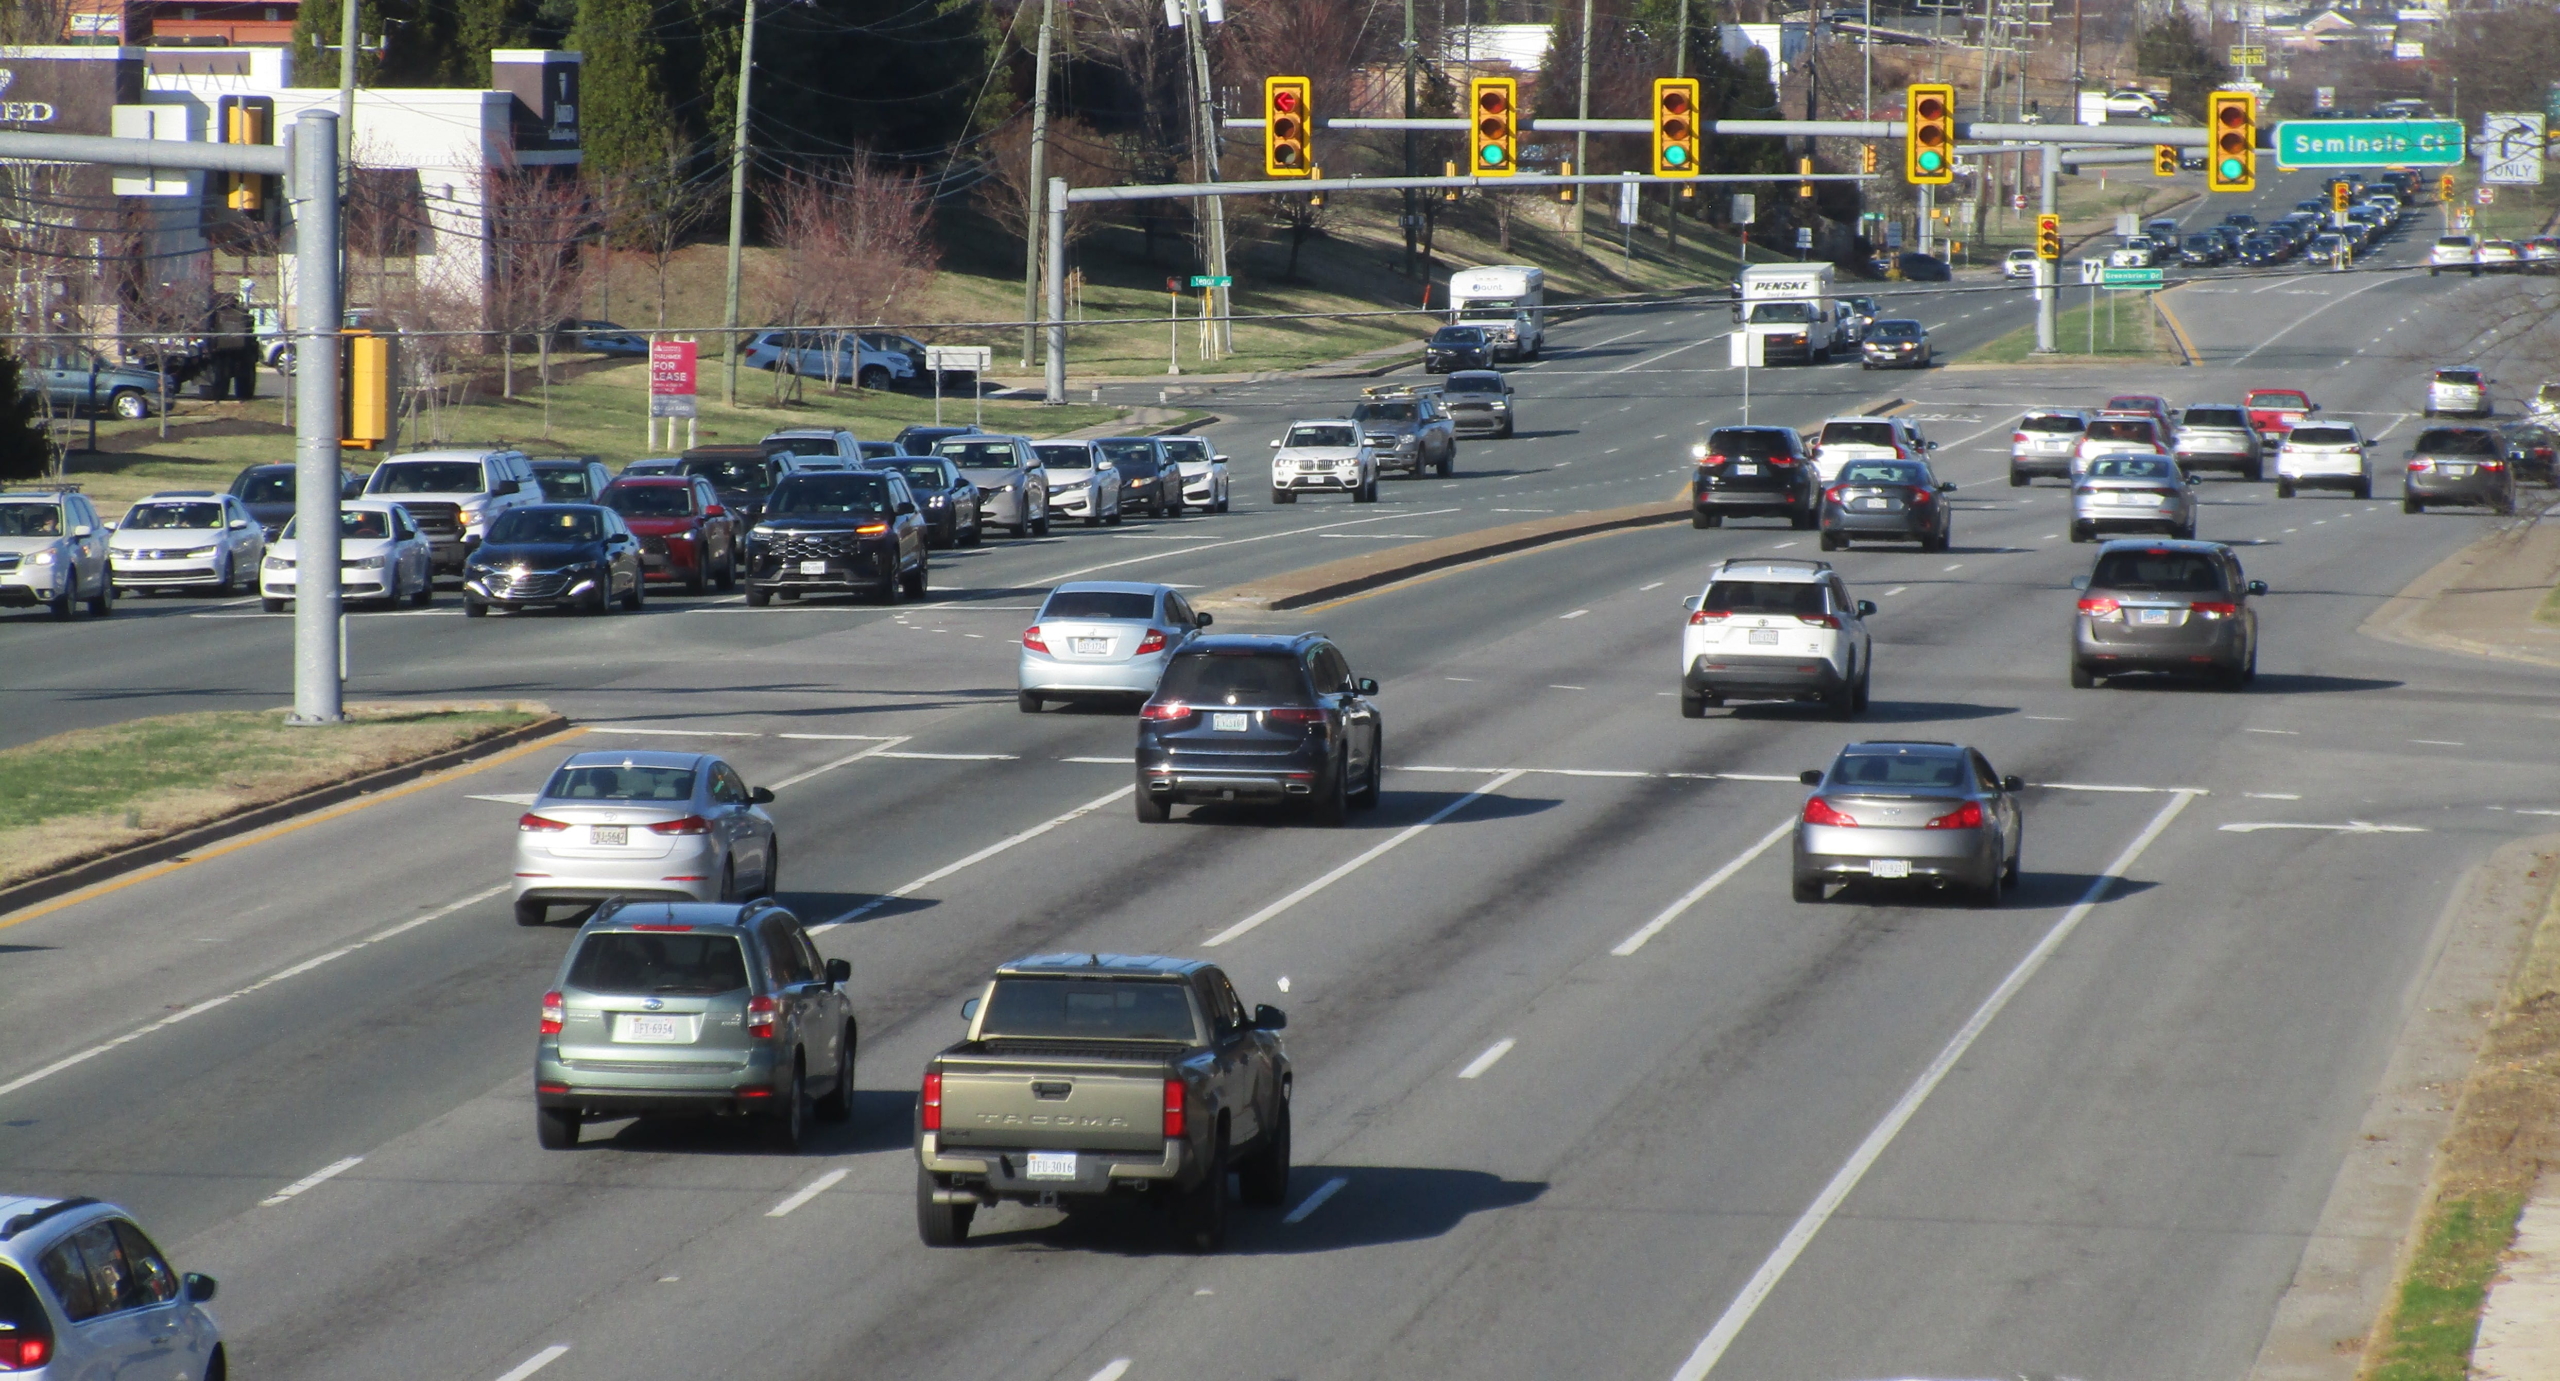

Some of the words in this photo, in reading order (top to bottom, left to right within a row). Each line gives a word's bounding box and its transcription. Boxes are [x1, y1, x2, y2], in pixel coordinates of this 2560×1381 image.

[2231, 55, 2266, 64] MOTEL
[2295, 135, 2407, 153] Seminole
[2420, 134, 2447, 152] Ct
[2494, 164, 2533, 177] ONLY
[1754, 281, 1809, 291] PENSKE
[653, 361, 676, 371] FOR
[652, 372, 687, 382] LEASE
[977, 1113, 1129, 1128] TACOMA
[1031, 1160, 1073, 1173] TFU-3016
